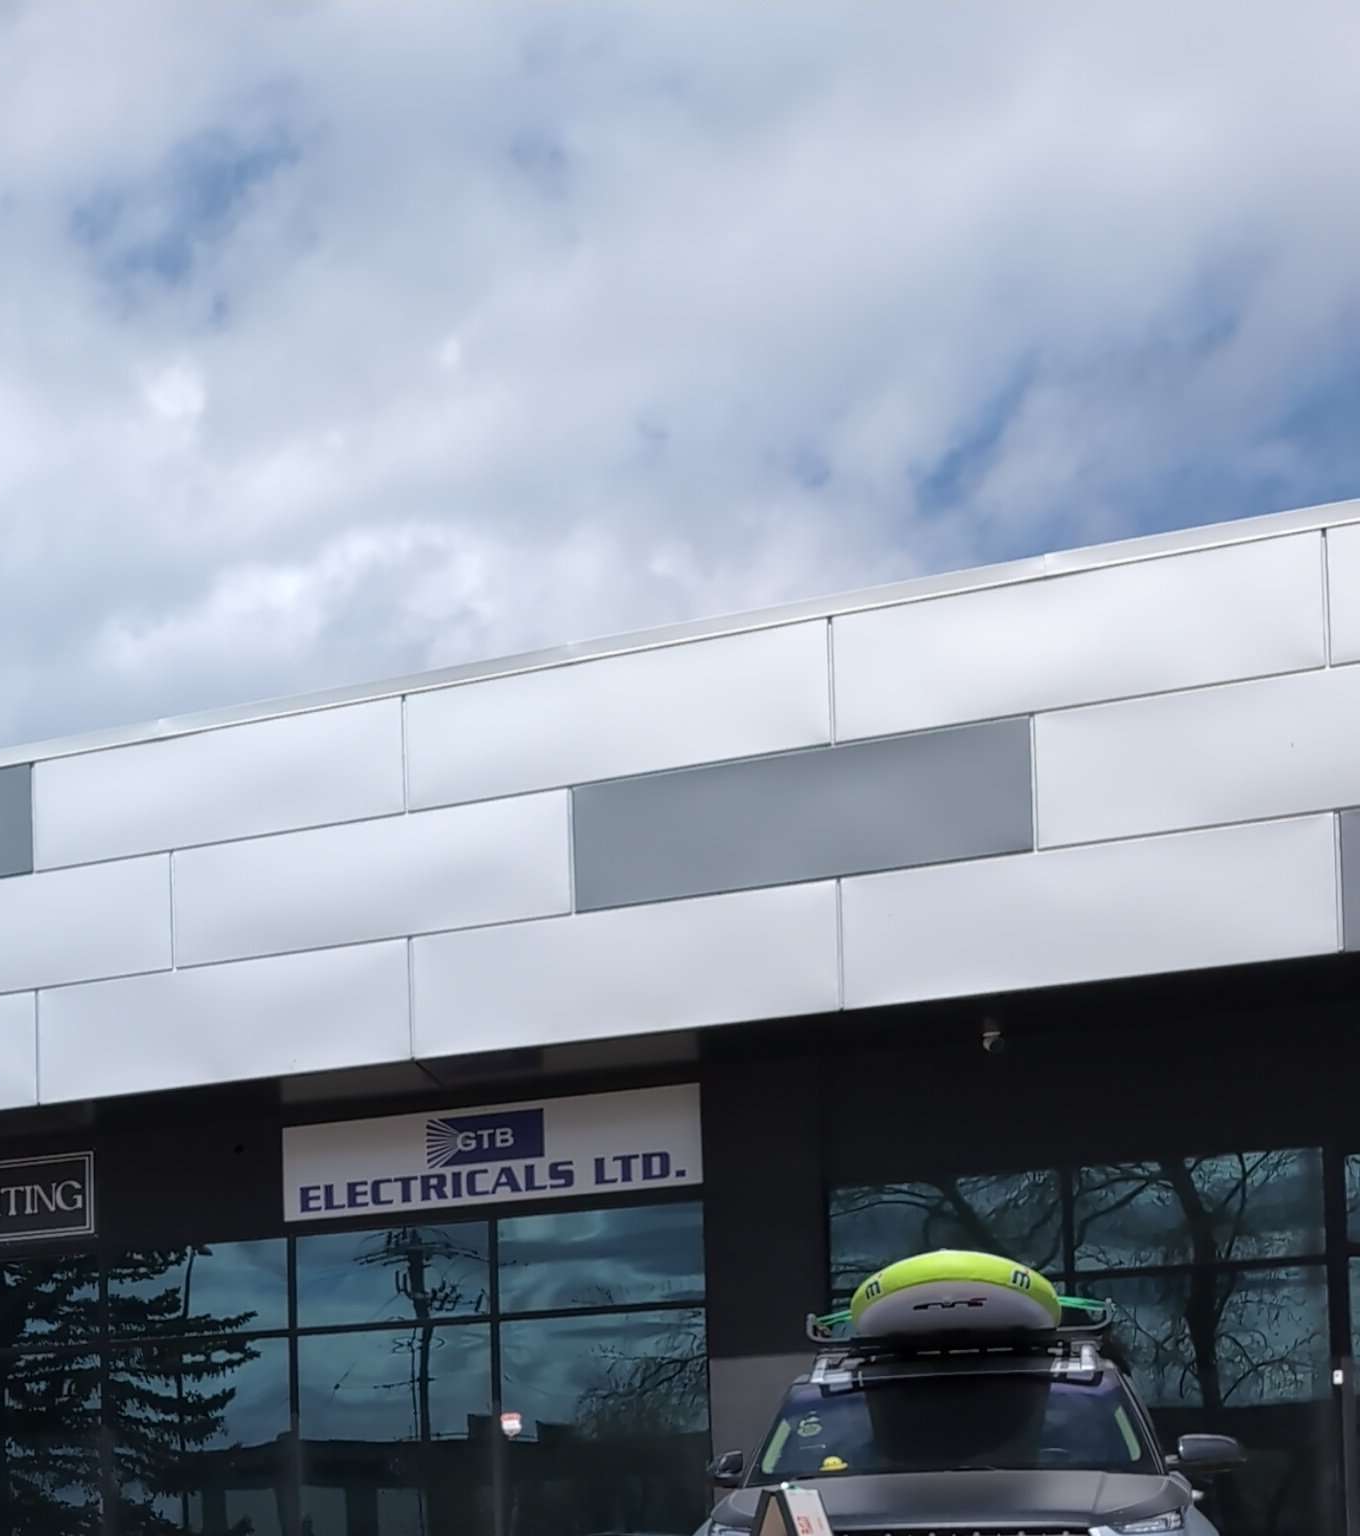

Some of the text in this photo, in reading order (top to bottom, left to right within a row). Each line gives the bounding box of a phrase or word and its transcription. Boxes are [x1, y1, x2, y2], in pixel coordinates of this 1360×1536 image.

[456, 1127, 515, 1152] GTB
[299, 1151, 687, 1213] ELECTRICALS LTD.
